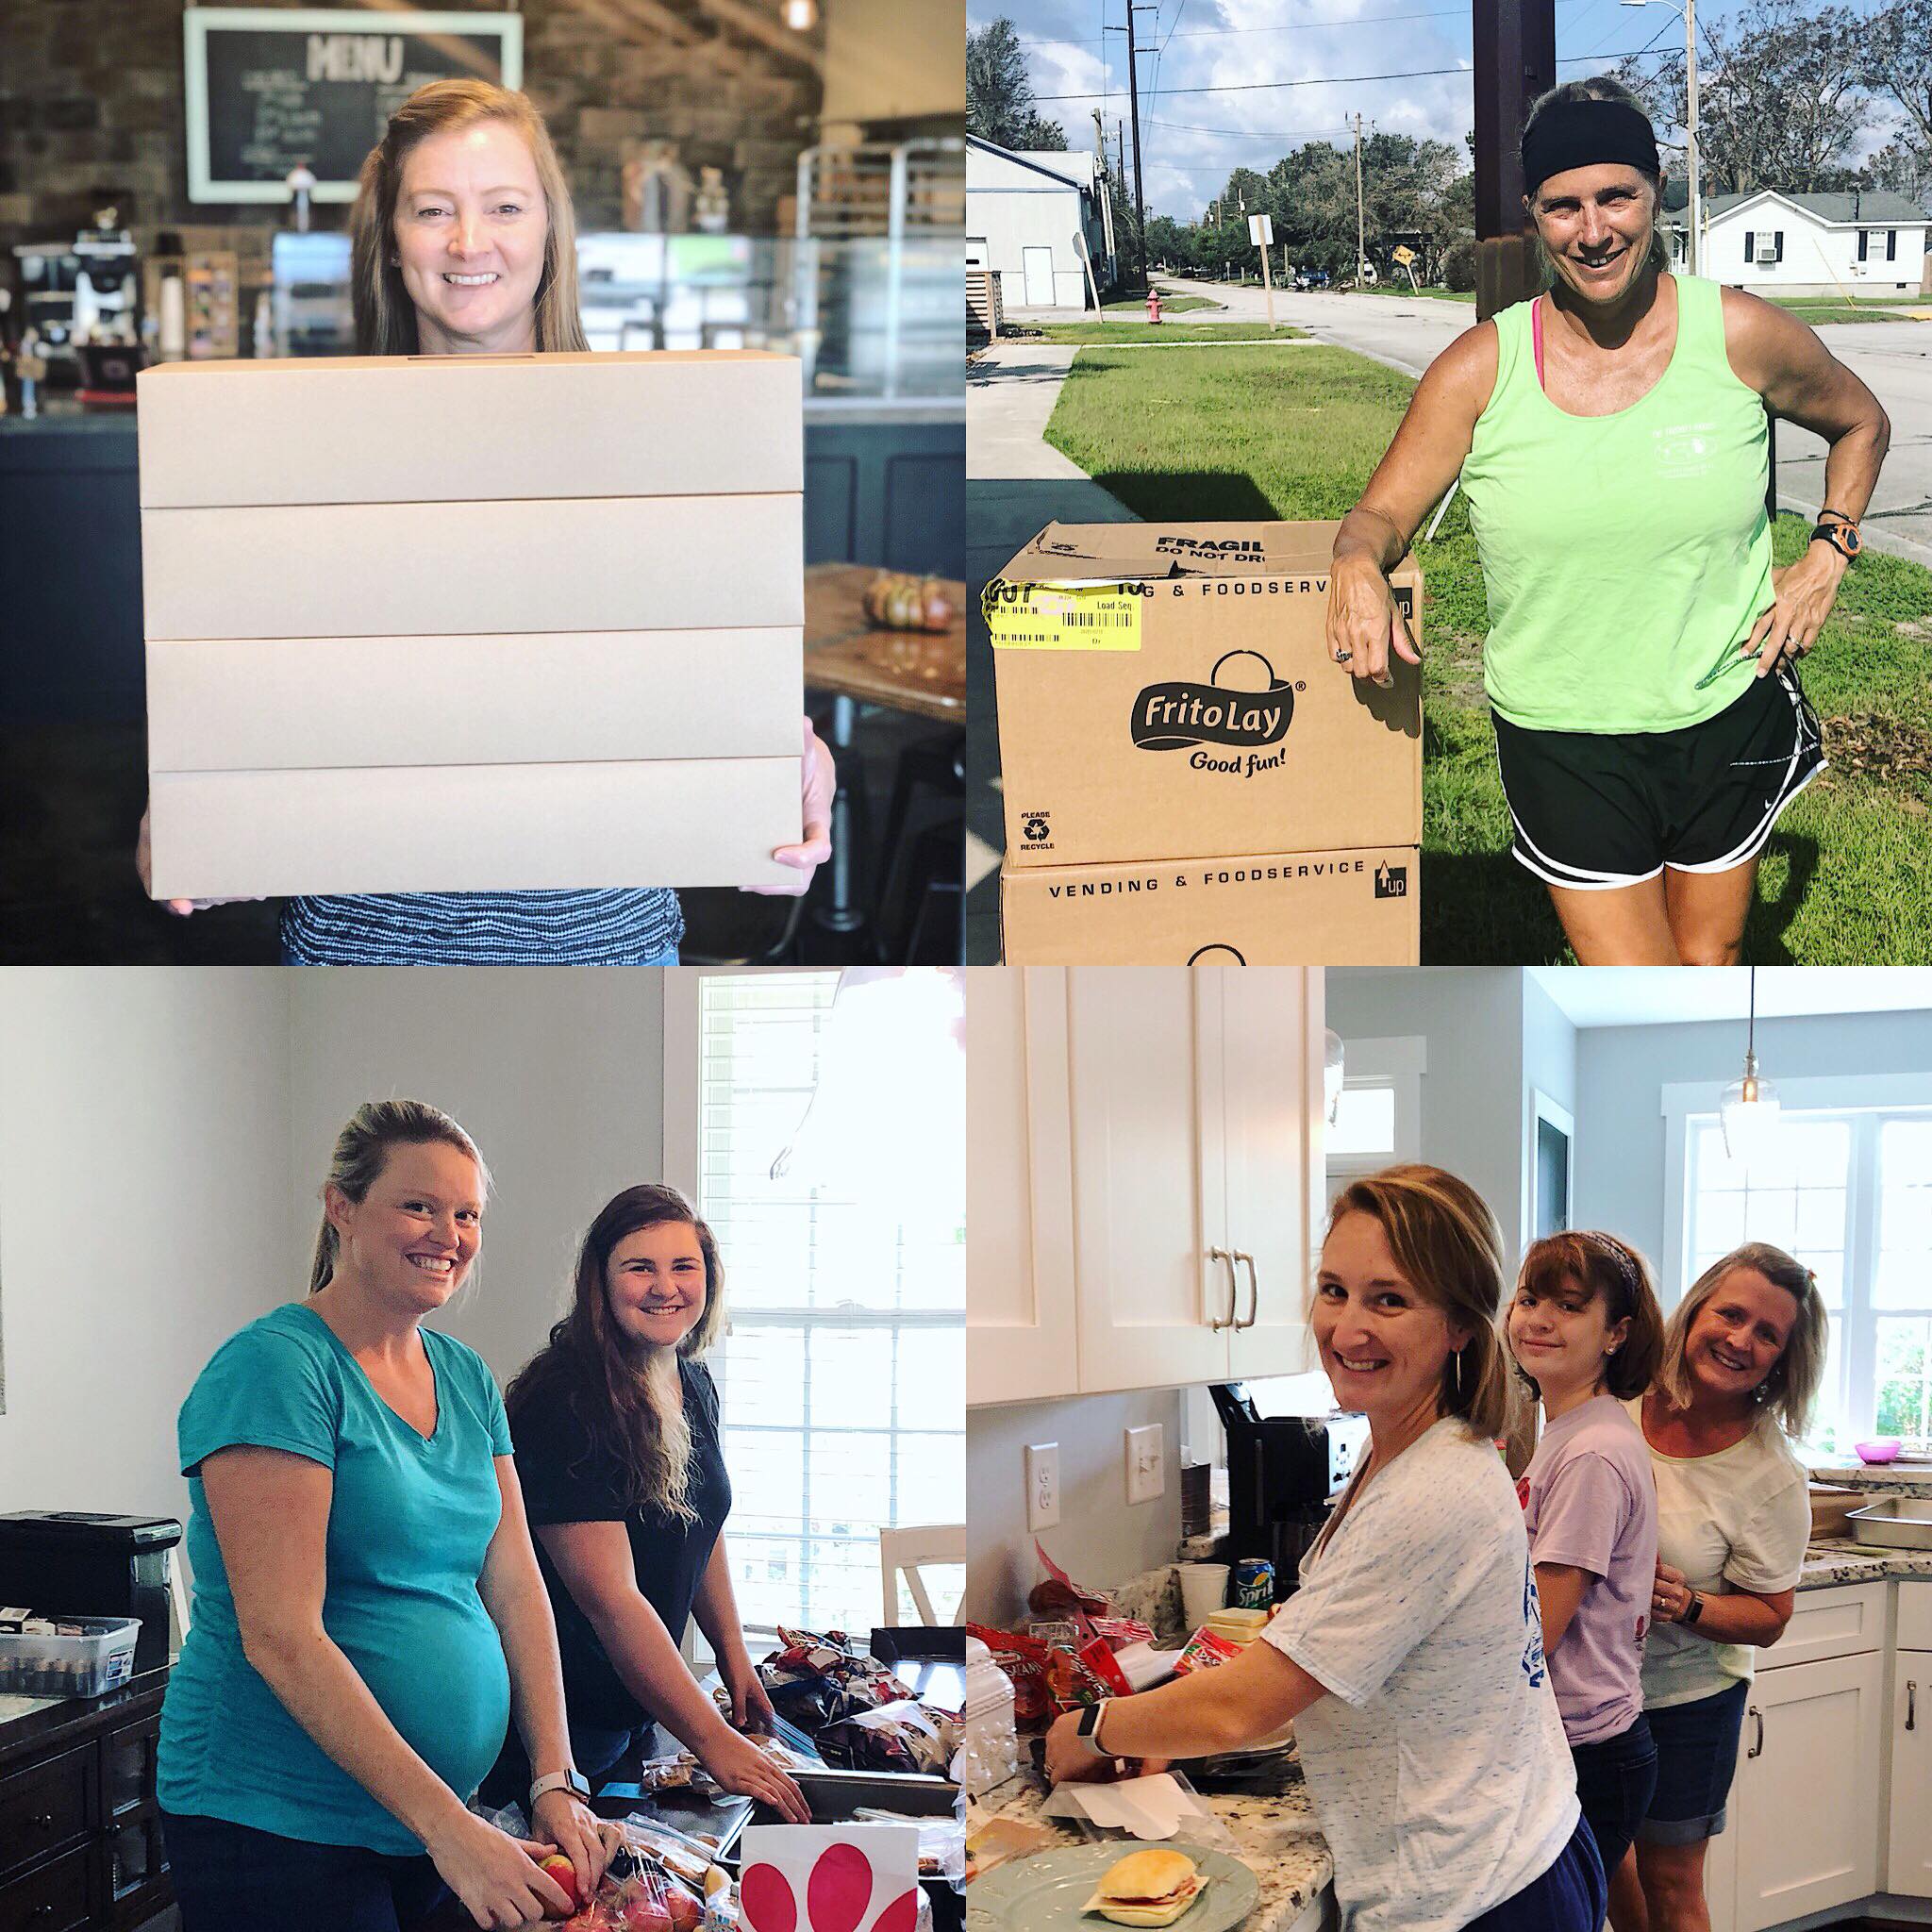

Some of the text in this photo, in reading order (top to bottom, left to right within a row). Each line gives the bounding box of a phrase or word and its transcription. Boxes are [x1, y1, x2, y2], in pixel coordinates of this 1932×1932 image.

[307, 34, 404, 83] MENU
[1158, 537, 1264, 552] FRAGIL
[1155, 546, 1265, 563] DO NOT DR
[1203, 580, 1327, 595] FOODSERV
[1097, 602, 1115, 610] Load
[1190, 747, 1286, 778] Good fun!
[1049, 860, 1364, 897] VENDING & FOODSERVICE
[1388, 879, 1404, 895] up
